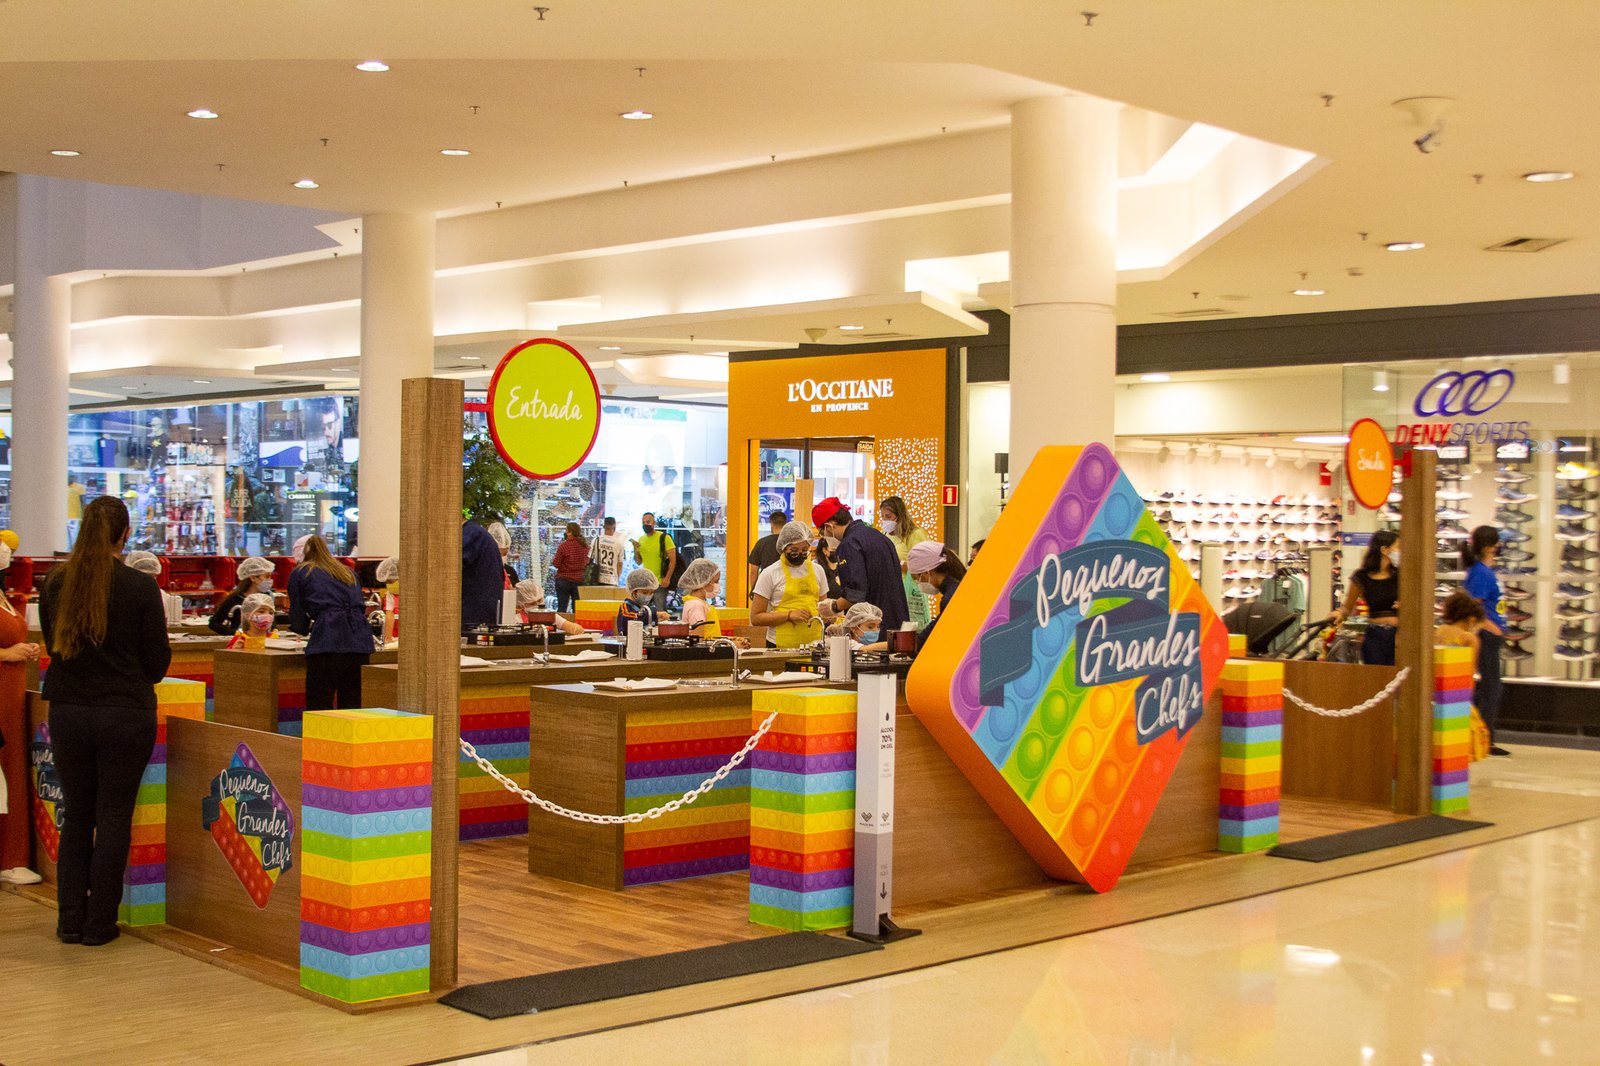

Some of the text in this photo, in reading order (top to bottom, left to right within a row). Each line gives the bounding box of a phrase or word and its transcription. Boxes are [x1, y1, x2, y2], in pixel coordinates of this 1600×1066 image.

[506, 385, 583, 421] Entrada
[788, 378, 893, 402] L'OCCITANE
[811, 402, 869, 412] EN PROVENCE
[1036, 553, 1167, 629] Pequenos
[1080, 609, 1200, 684] Grandes
[1137, 673, 1202, 736] Chefs
[881, 735, 893, 743] 70%
[220, 768, 271, 801] Pequenos
[237, 801, 289, 839] Grandes
[262, 840, 291, 870] Chefs
